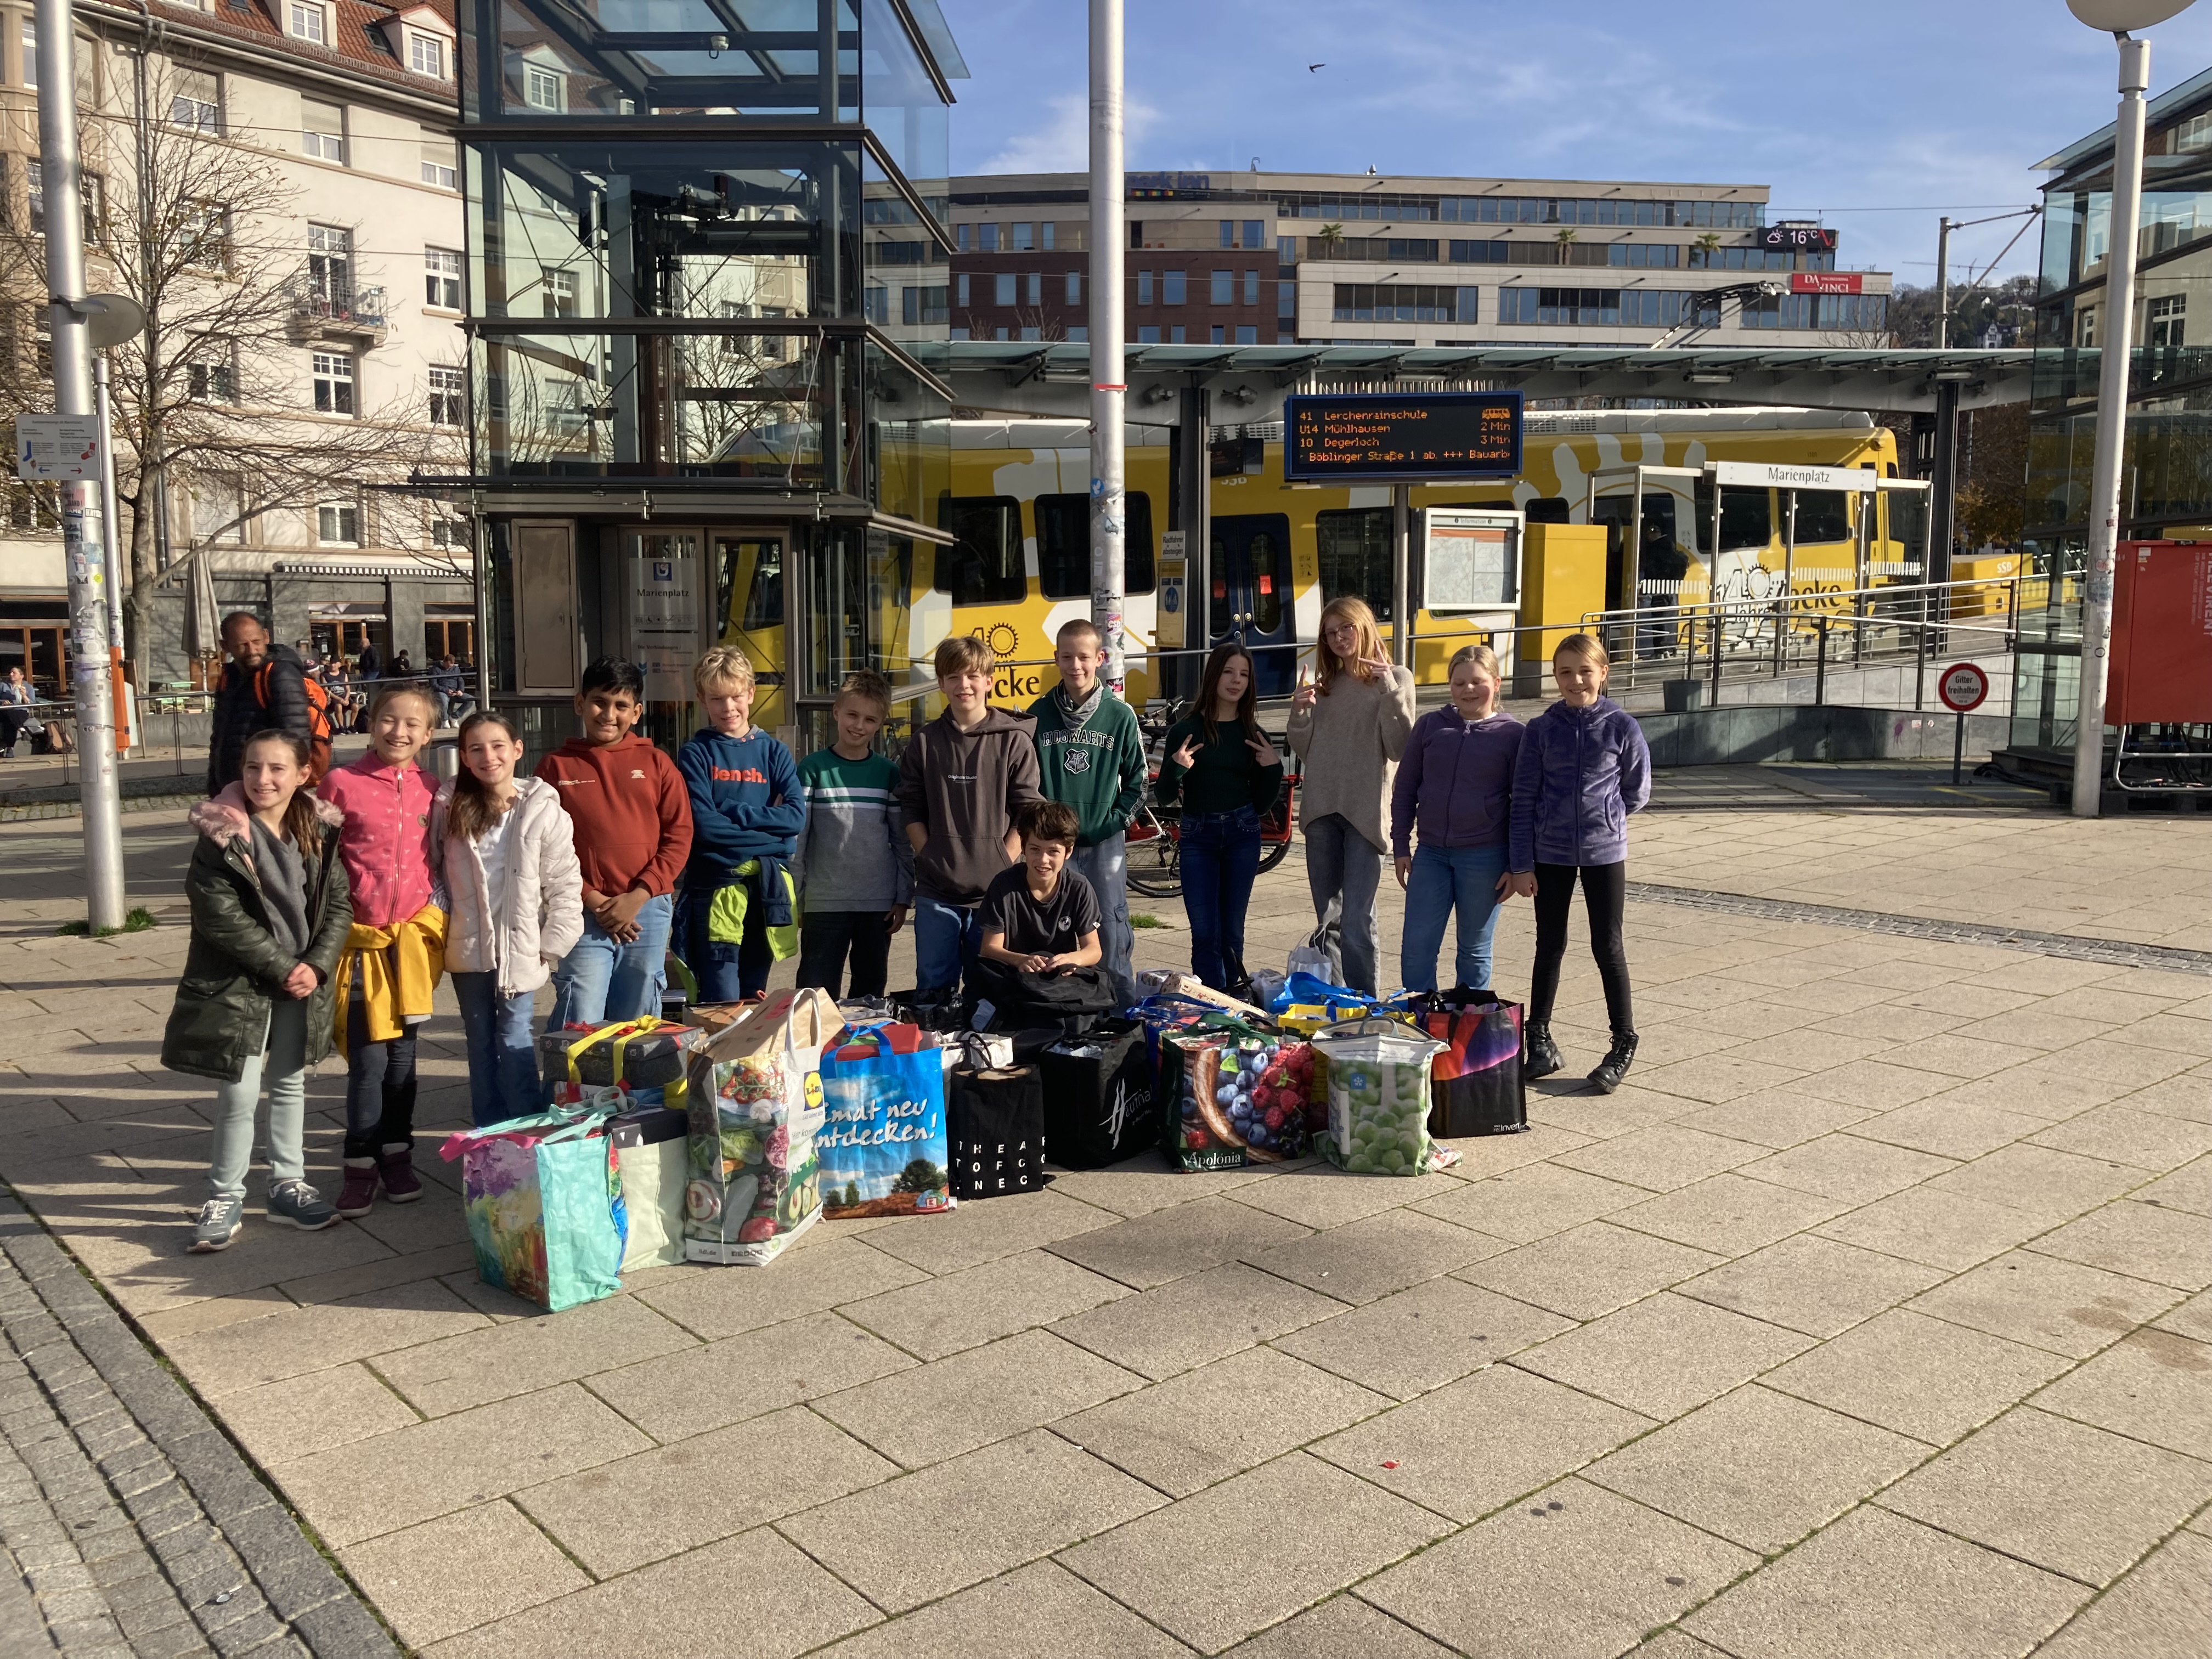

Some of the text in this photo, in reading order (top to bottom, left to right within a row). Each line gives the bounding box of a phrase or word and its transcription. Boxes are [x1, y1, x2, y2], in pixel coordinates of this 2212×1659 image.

[1790, 229, 1818, 245] 16°C
[1300, 410, 1427, 421] 41 Lerchenrainschule
[1300, 422, 1510, 435] U14 Mühlhausen 2 Min
[1300, 435, 1510, 448] 10 Degerloch 3 Min
[1310, 452, 1363, 463] Böblinger
[1368, 452, 1404, 462] Straße
[1410, 452, 1415, 460] 1
[1469, 449, 1510, 459] Bauarb
[1768, 466, 1830, 485] Marienplatz
[1997, 561, 2012, 573] SSB
[637, 589, 690, 599] Marienplatz
[985, 665, 1040, 704] cke
[1955, 675, 1973, 684] Gitter
[1948, 686, 1979, 694] freihalten
[1043, 729, 1115, 751] HOGWARTS
[1188, 1152, 1241, 1169] Apolónia
